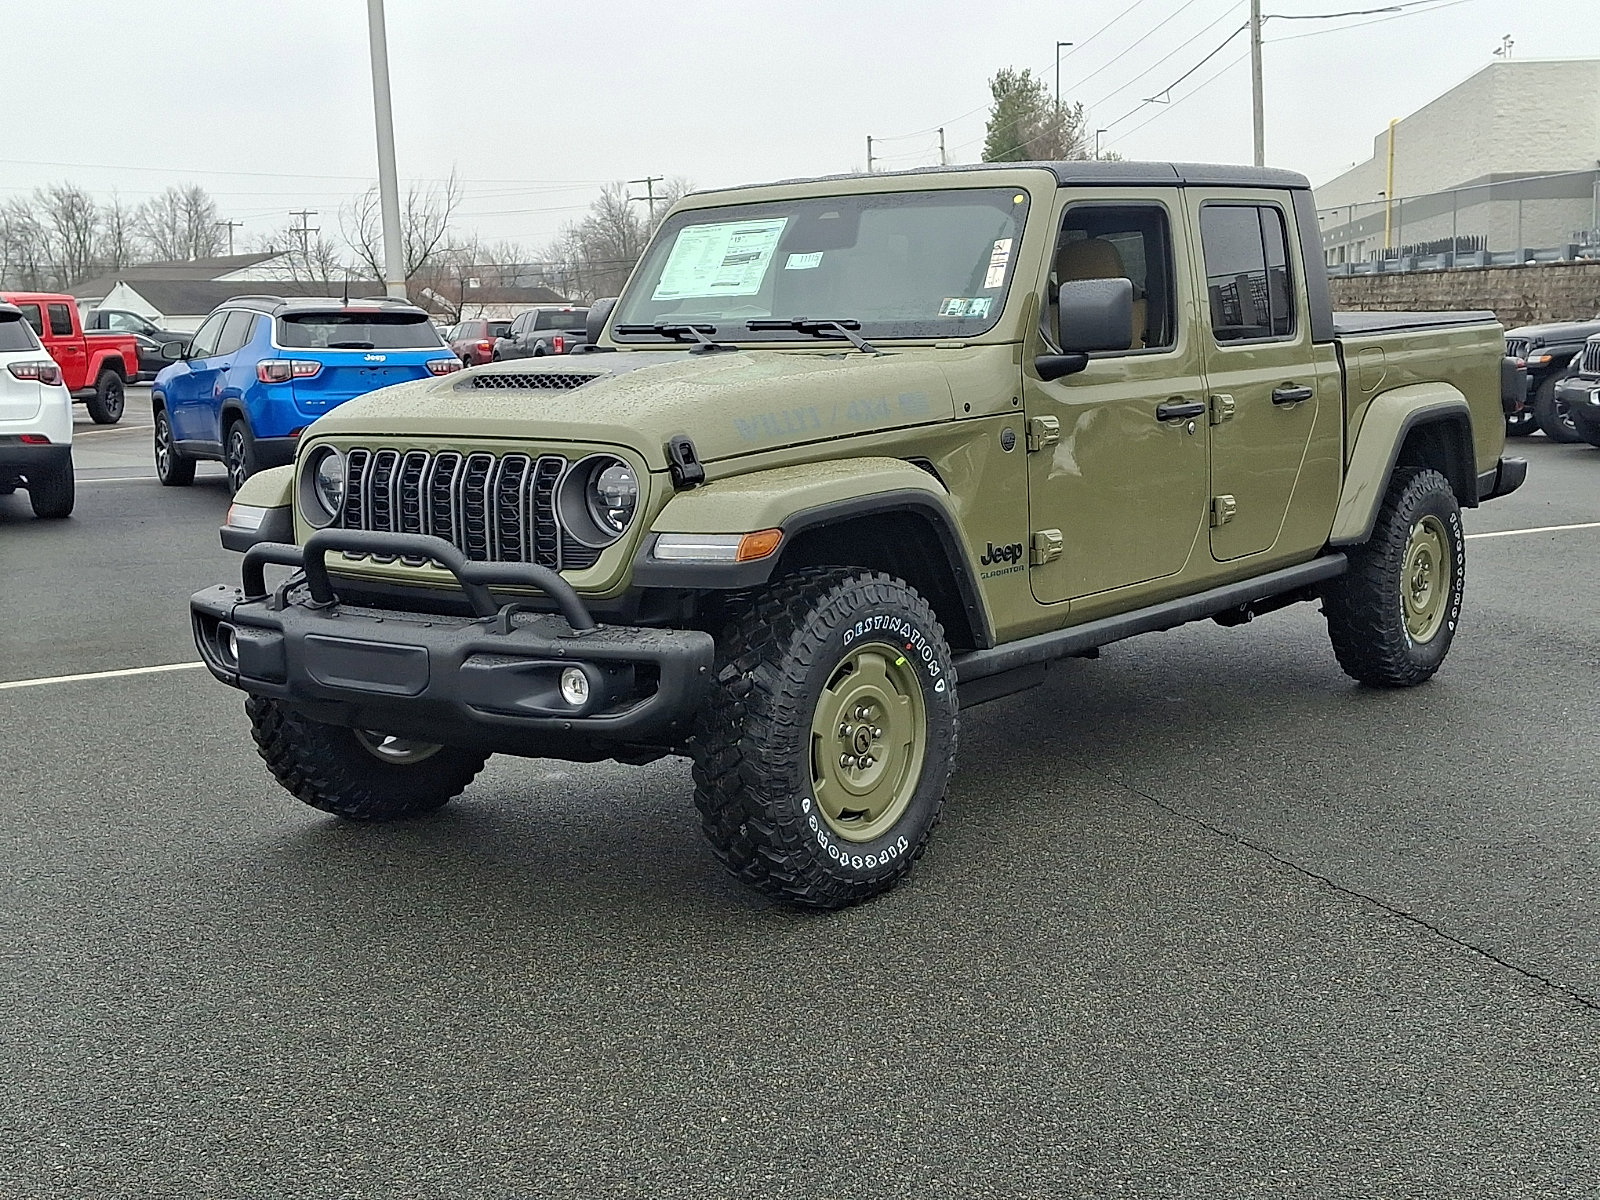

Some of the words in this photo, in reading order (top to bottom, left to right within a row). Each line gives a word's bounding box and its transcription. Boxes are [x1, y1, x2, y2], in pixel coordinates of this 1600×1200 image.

[364, 353, 386, 362] Jeep
[980, 542, 1023, 566] Jeep
[980, 565, 1025, 580] GLADIATOR
[843, 615, 940, 676] DESTINATION
[808, 816, 909, 870] Firestone
